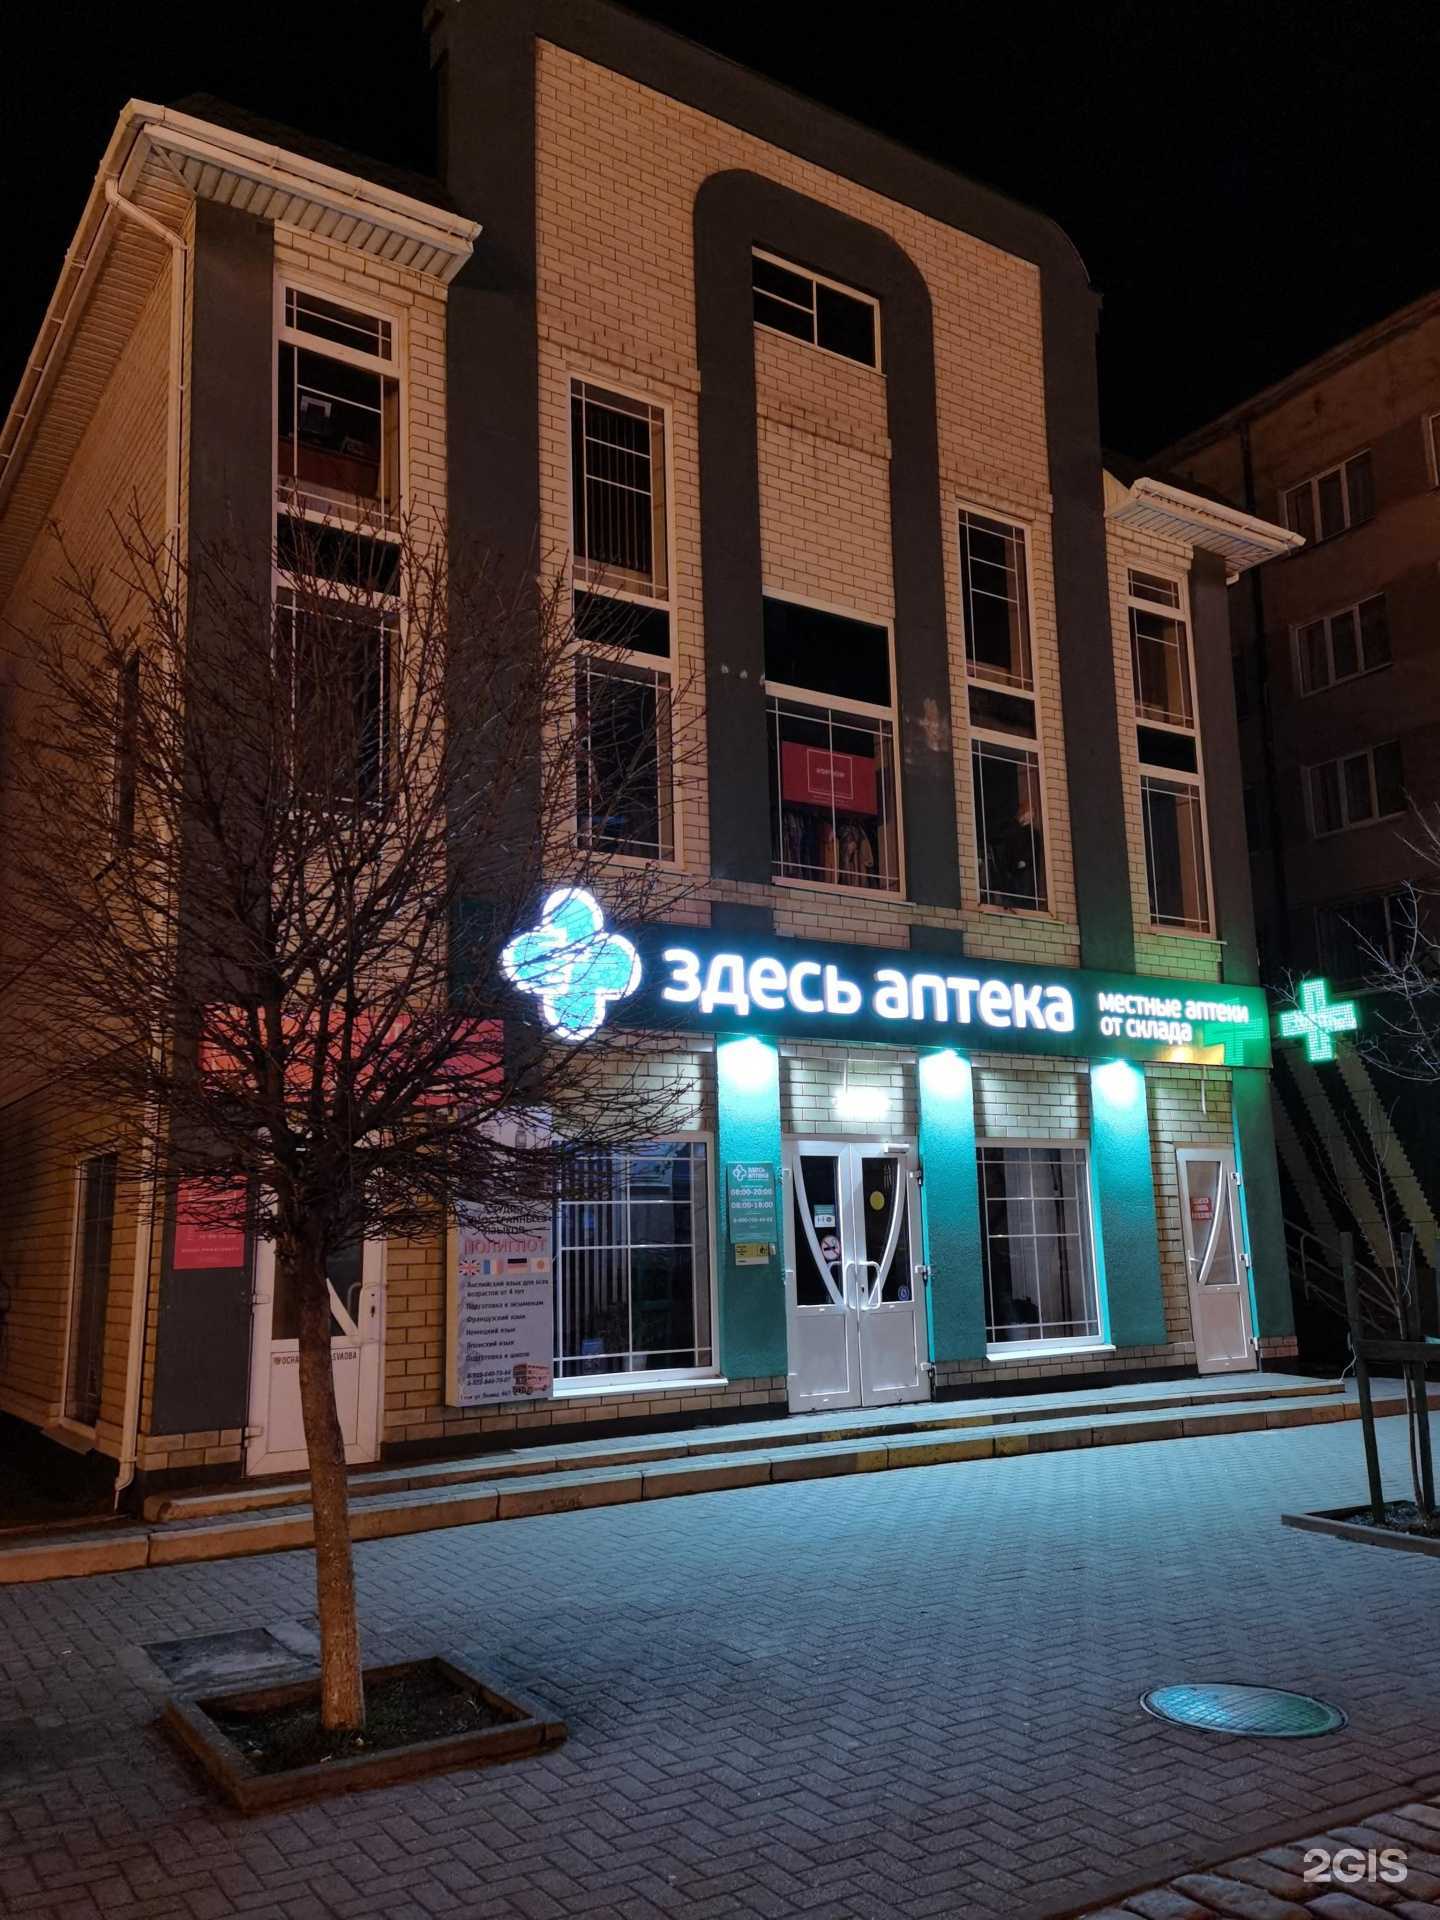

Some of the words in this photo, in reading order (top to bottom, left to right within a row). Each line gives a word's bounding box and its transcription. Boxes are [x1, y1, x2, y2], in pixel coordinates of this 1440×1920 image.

[662, 948, 862, 1016] здесь
[873, 969, 1076, 1032] аптека
[1098, 991, 1182, 1019] местные
[1184, 999, 1250, 1024] аптеки
[1100, 1016, 1124, 1037] от
[1125, 1018, 1193, 1045] склада
